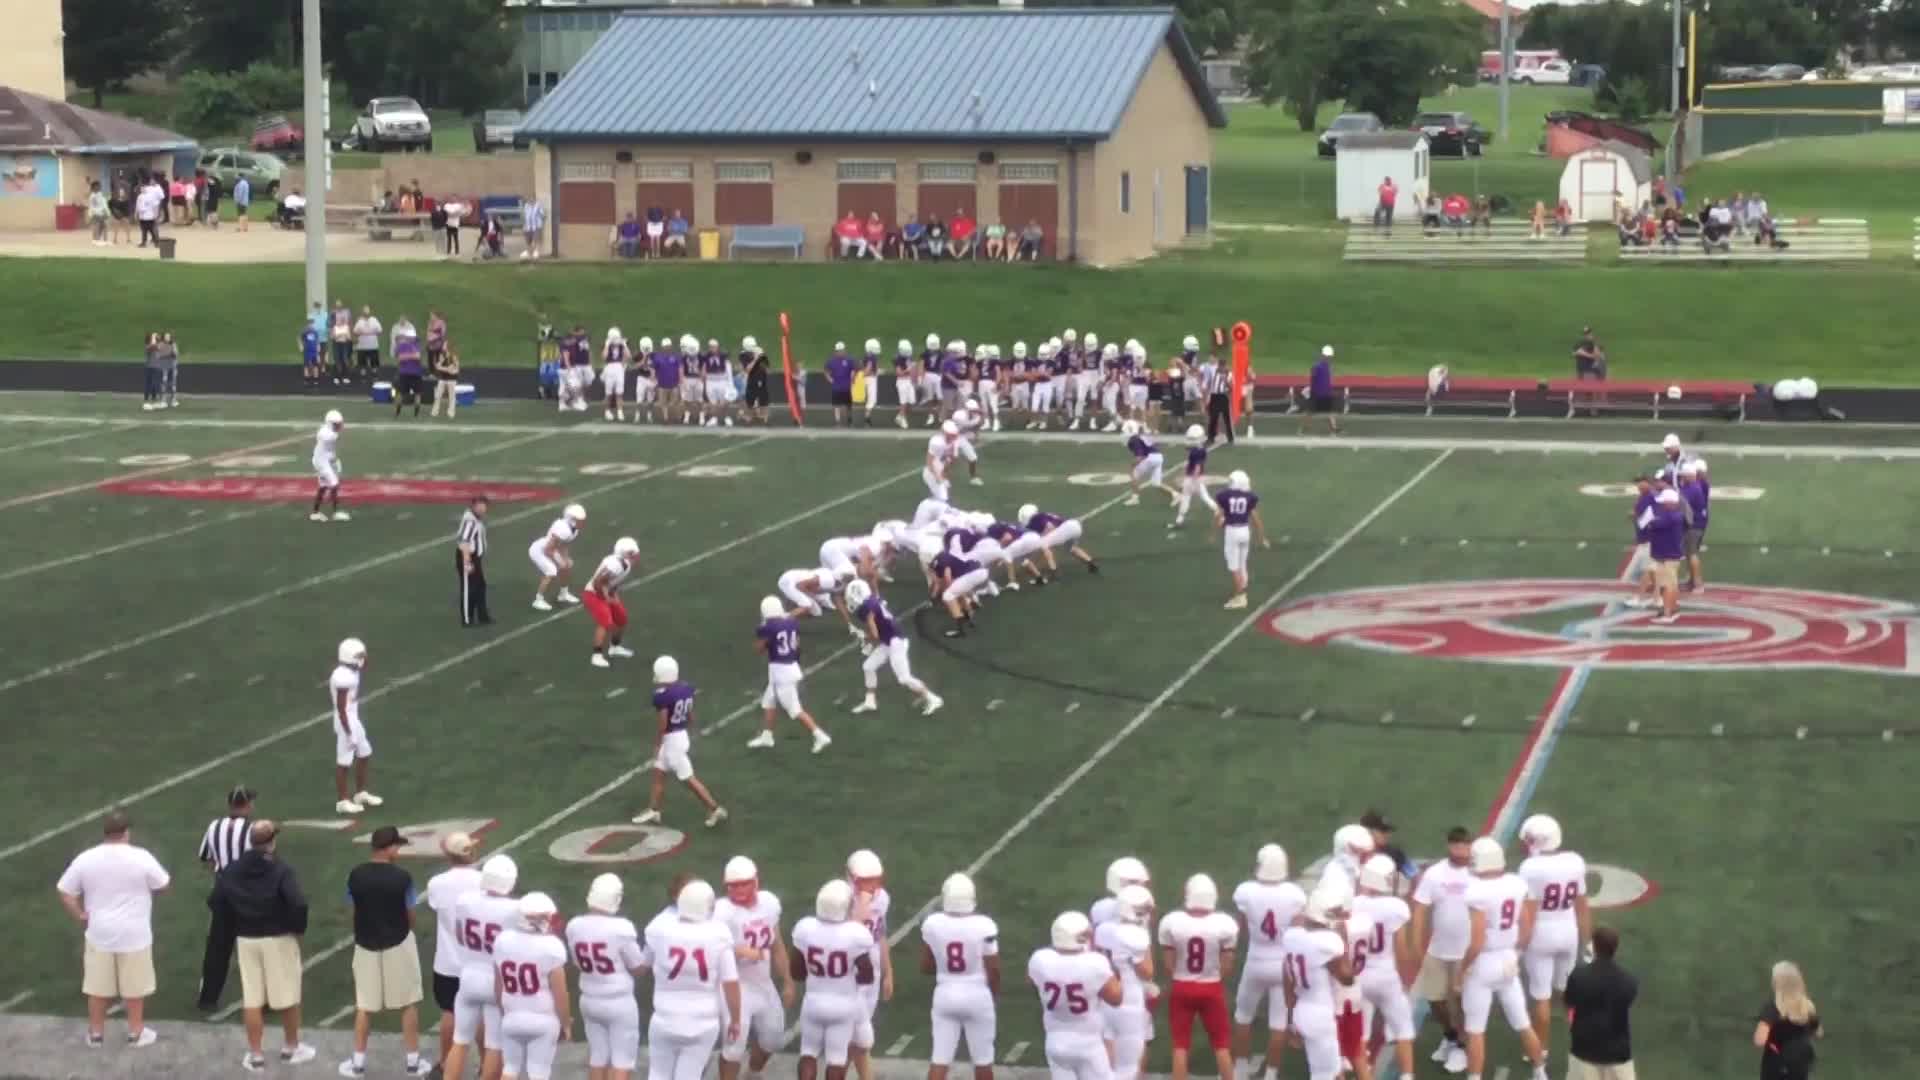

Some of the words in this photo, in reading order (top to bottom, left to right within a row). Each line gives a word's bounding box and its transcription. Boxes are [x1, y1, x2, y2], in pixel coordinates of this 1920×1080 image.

[1229, 497, 1247, 514] 10
[1542, 882, 1578, 911] 88
[1260, 909, 1278, 941] 4
[1500, 898, 1515, 930] 9
[575, 941, 616, 975] 65
[667, 946, 709, 982] 71
[807, 946, 849, 979] 50
[946, 941, 967, 973] 8
[1187, 936, 1206, 974] 8
[501, 960, 540, 996] 60
[1043, 981, 1090, 1015] 75
